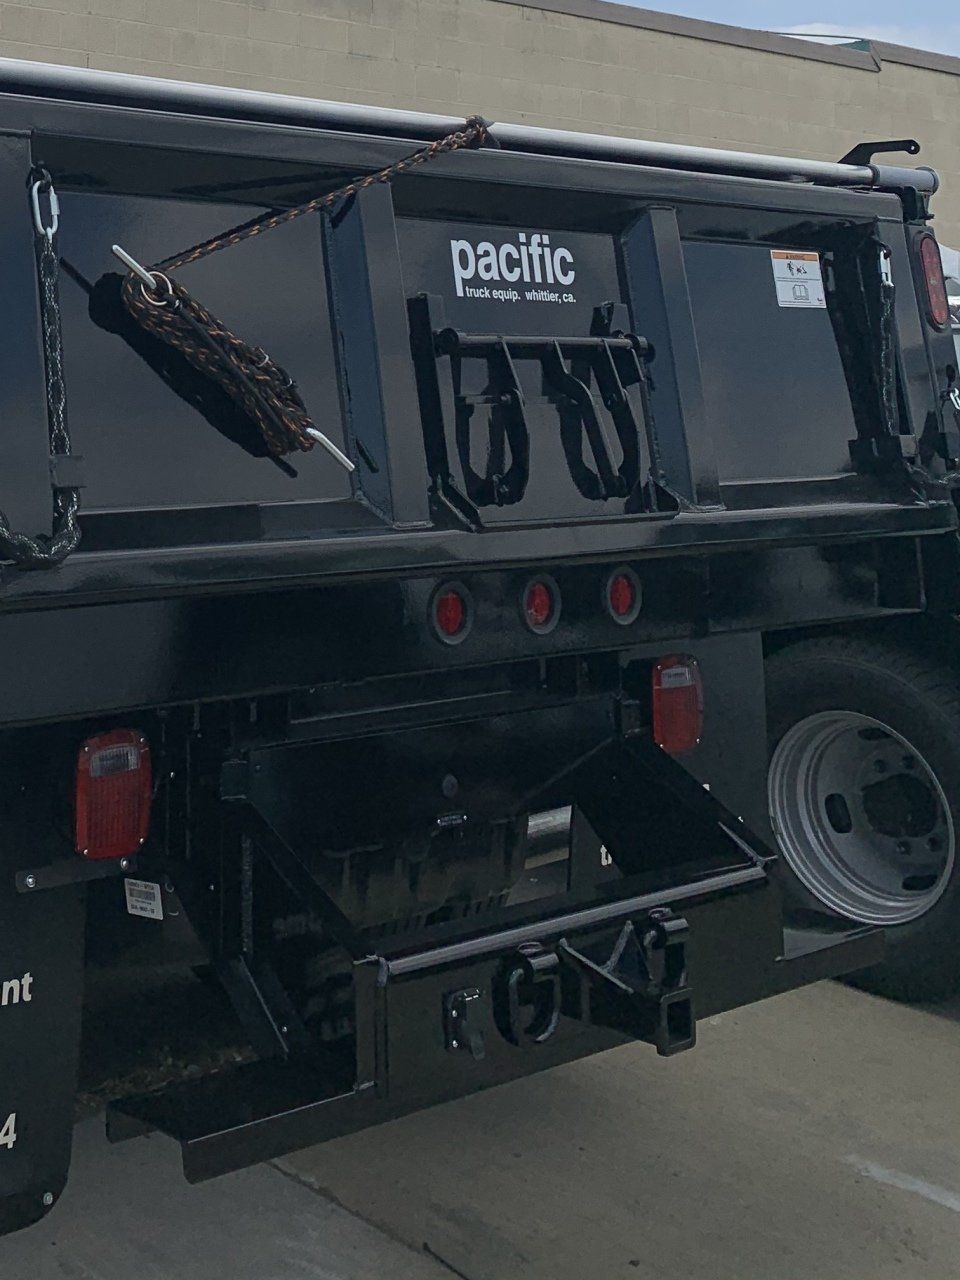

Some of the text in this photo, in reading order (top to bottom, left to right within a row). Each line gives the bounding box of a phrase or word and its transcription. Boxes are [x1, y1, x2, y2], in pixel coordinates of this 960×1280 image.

[450, 232, 576, 297] pacific
[465, 285, 577, 304] truck equip. whittier, ca.
